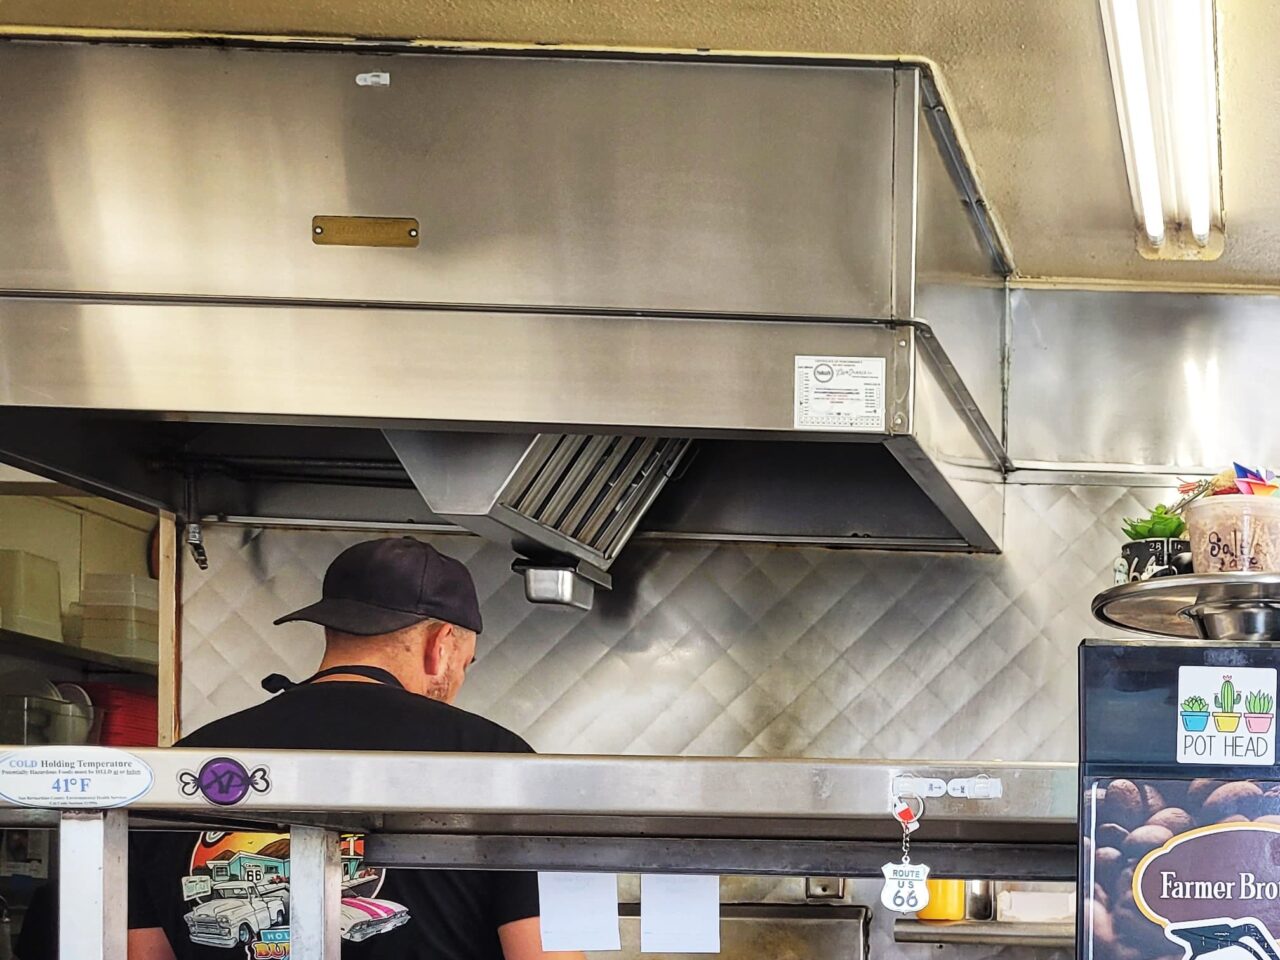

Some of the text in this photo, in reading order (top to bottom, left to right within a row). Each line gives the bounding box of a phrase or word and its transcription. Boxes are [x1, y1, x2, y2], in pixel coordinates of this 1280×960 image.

[1184, 735, 1268, 757] POT HEAD
[9, 760, 133, 770] COLD Holding Temperature
[246, 869, 262, 883] 66
[893, 869, 920, 878] ROUTE
[1160, 871, 1236, 899] Farmer
[893, 890, 918, 907] 66
